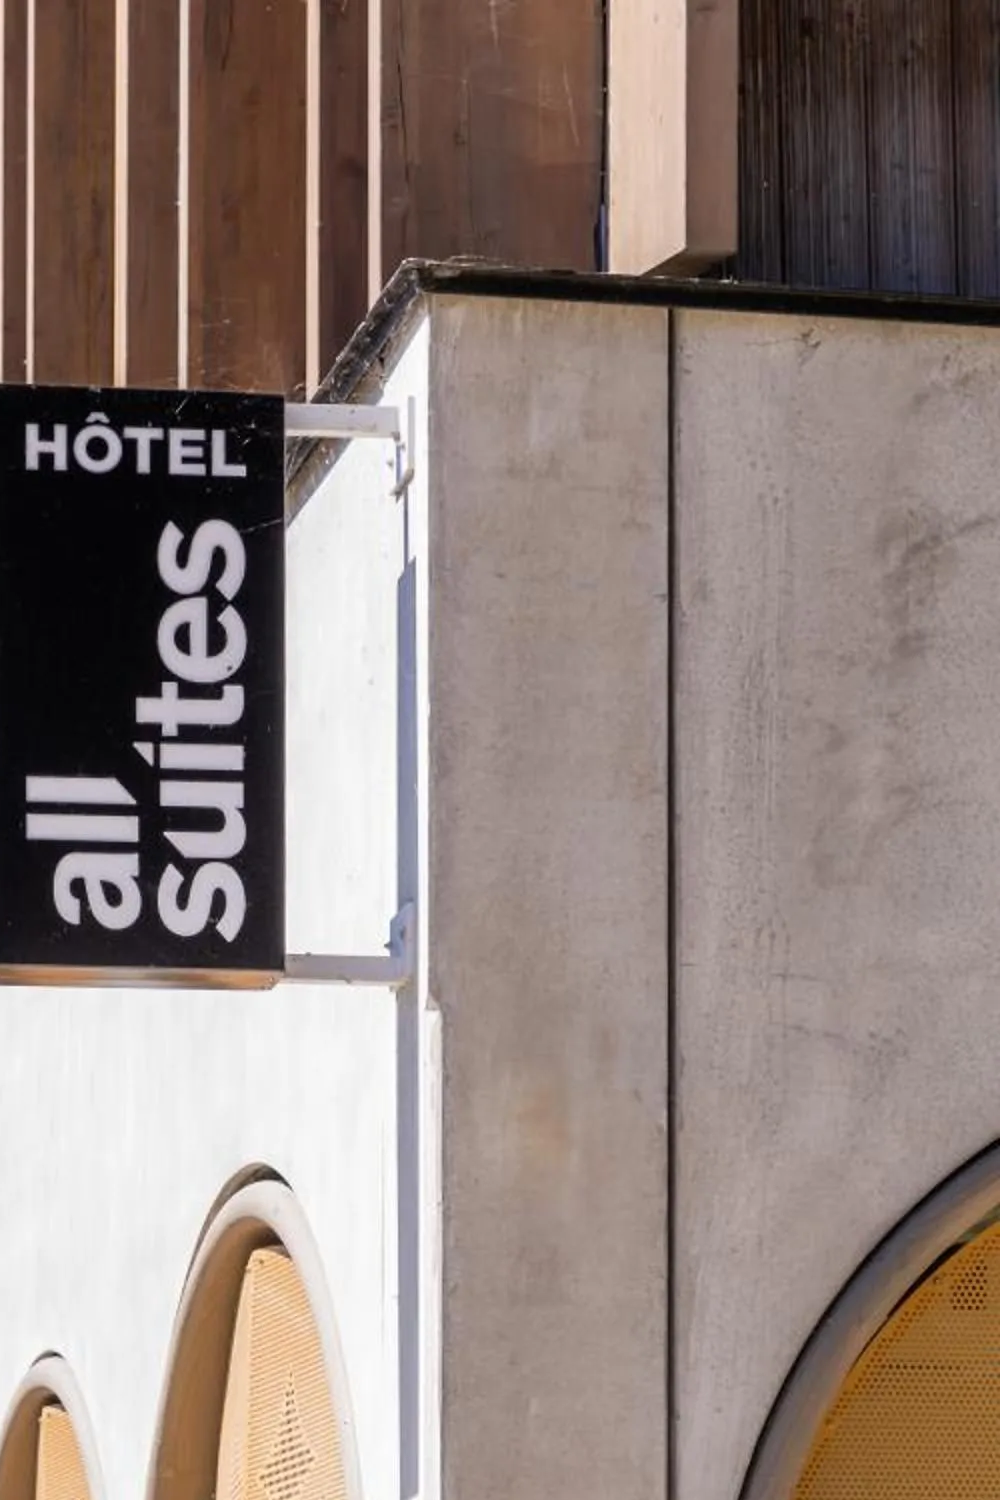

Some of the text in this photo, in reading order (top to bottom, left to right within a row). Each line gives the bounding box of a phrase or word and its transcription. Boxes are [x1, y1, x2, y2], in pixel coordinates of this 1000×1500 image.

[25, 412, 248, 477] HÔTEL
[134, 518, 248, 943] suites
[25, 776, 142, 930] all
